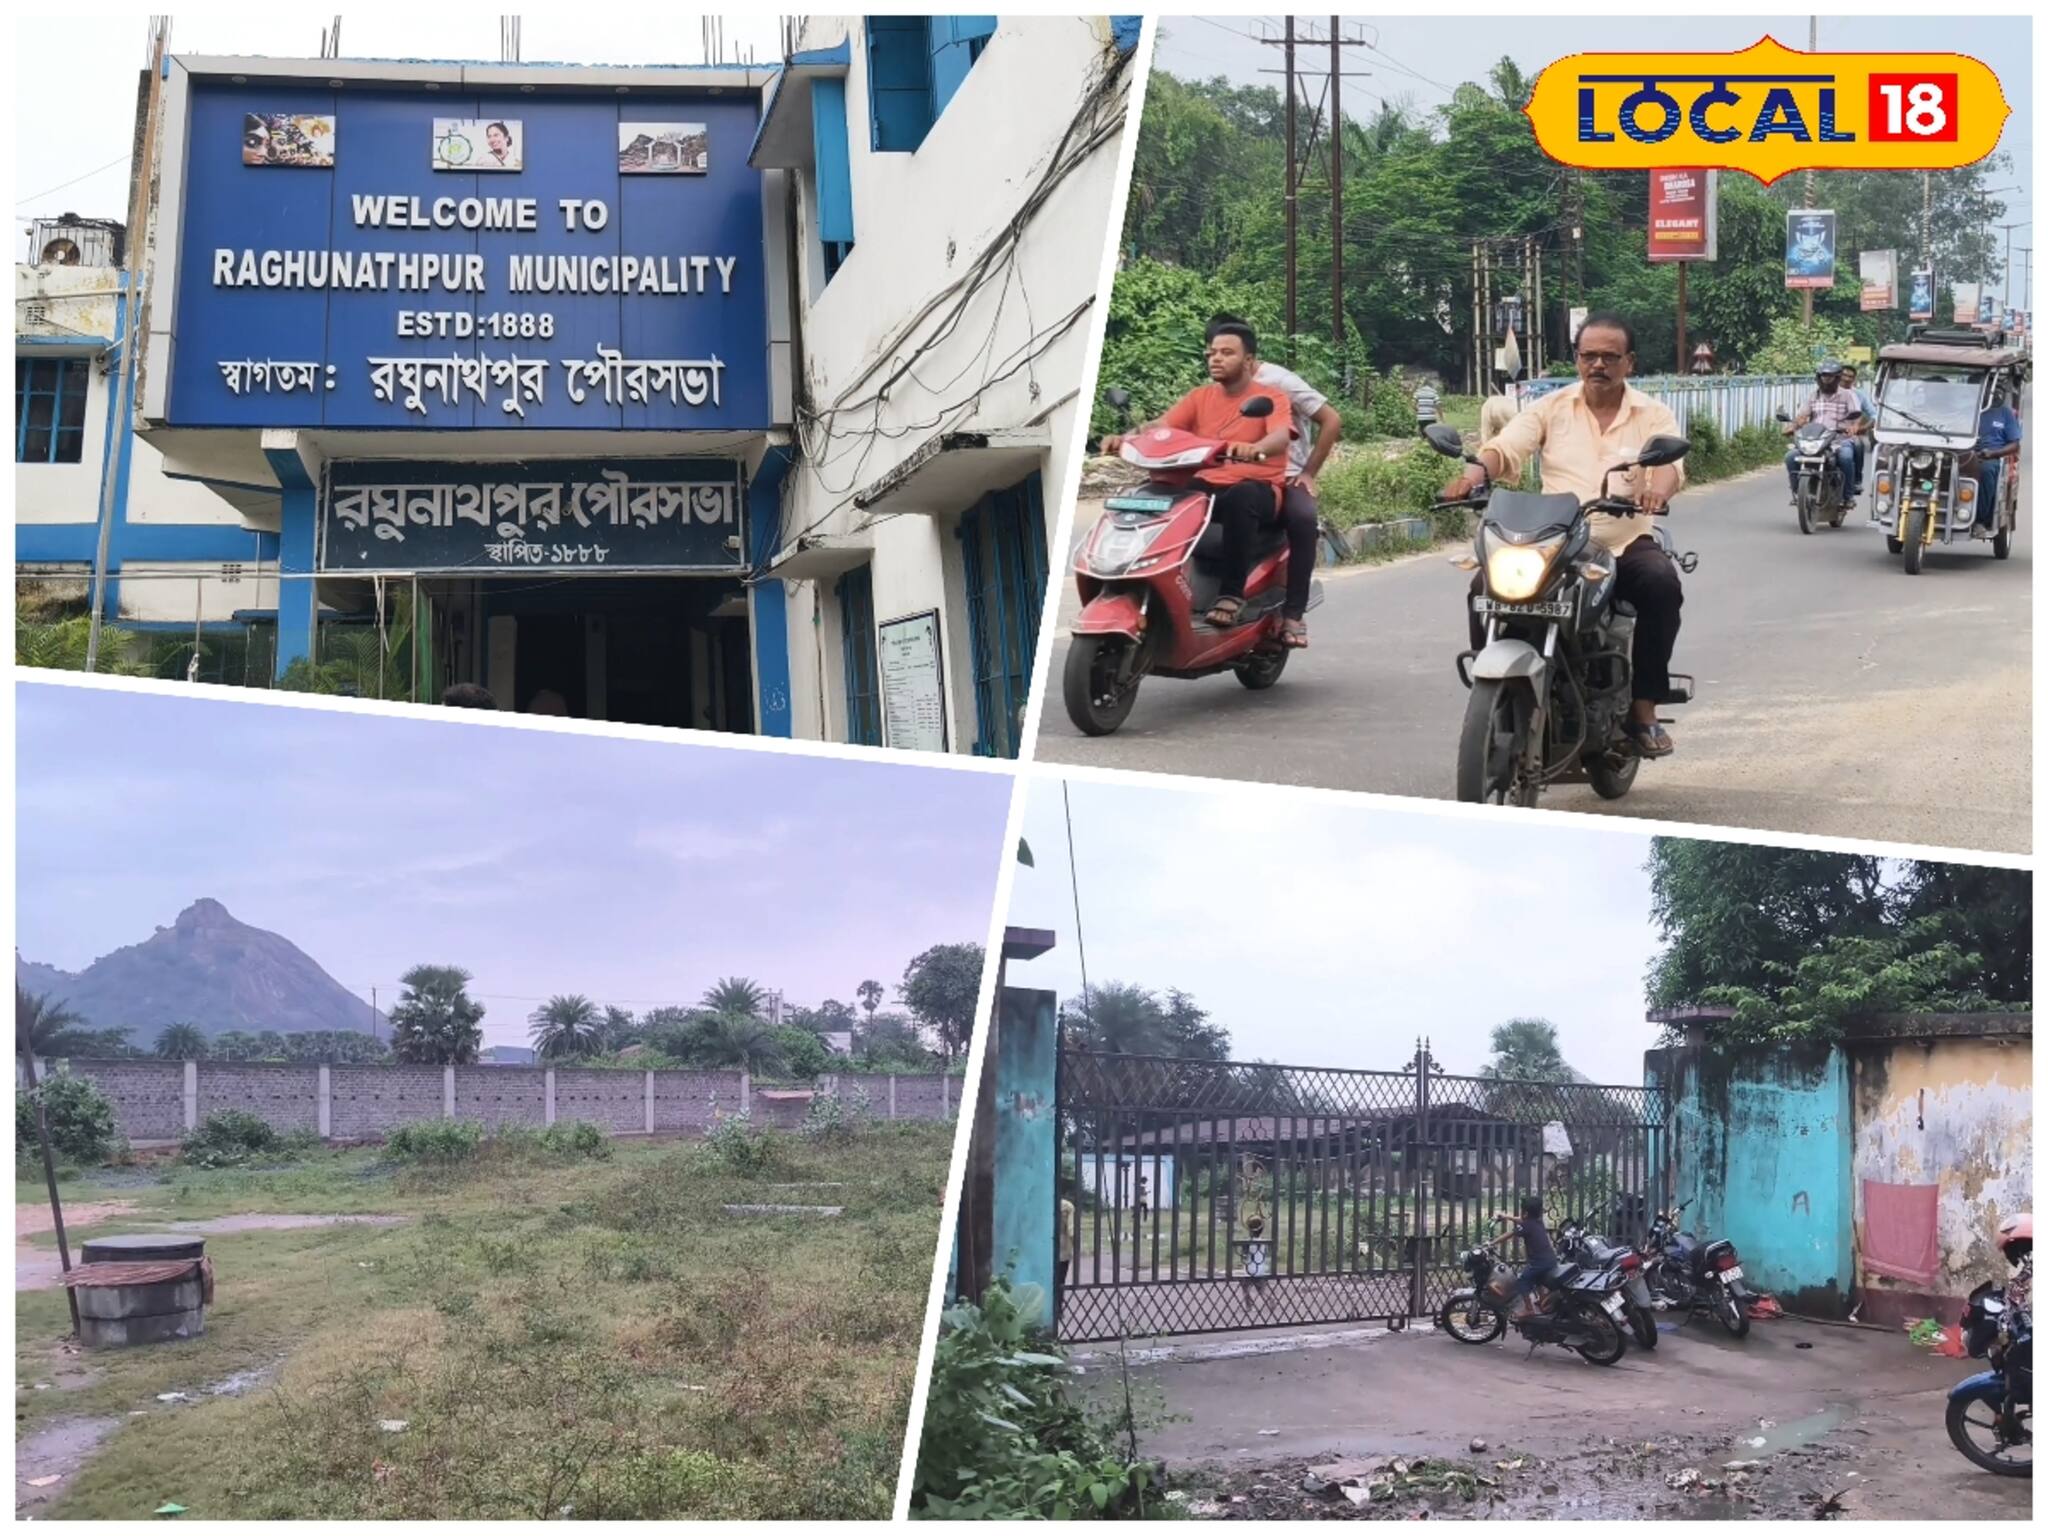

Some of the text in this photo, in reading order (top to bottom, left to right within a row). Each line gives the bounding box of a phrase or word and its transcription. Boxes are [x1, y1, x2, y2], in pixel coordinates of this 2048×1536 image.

[352, 195, 609, 230] WELCOME TO
[213, 248, 738, 294] RAGHUNATHPUR MUNICIPALITY
[397, 310, 555, 338] ESTD:1888
[367, 351, 549, 417] রঘুনাথপুর
[561, 342, 725, 408] পৌরসভা
[334, 468, 735, 543] রঘুনাথপুর পৌরসভা
